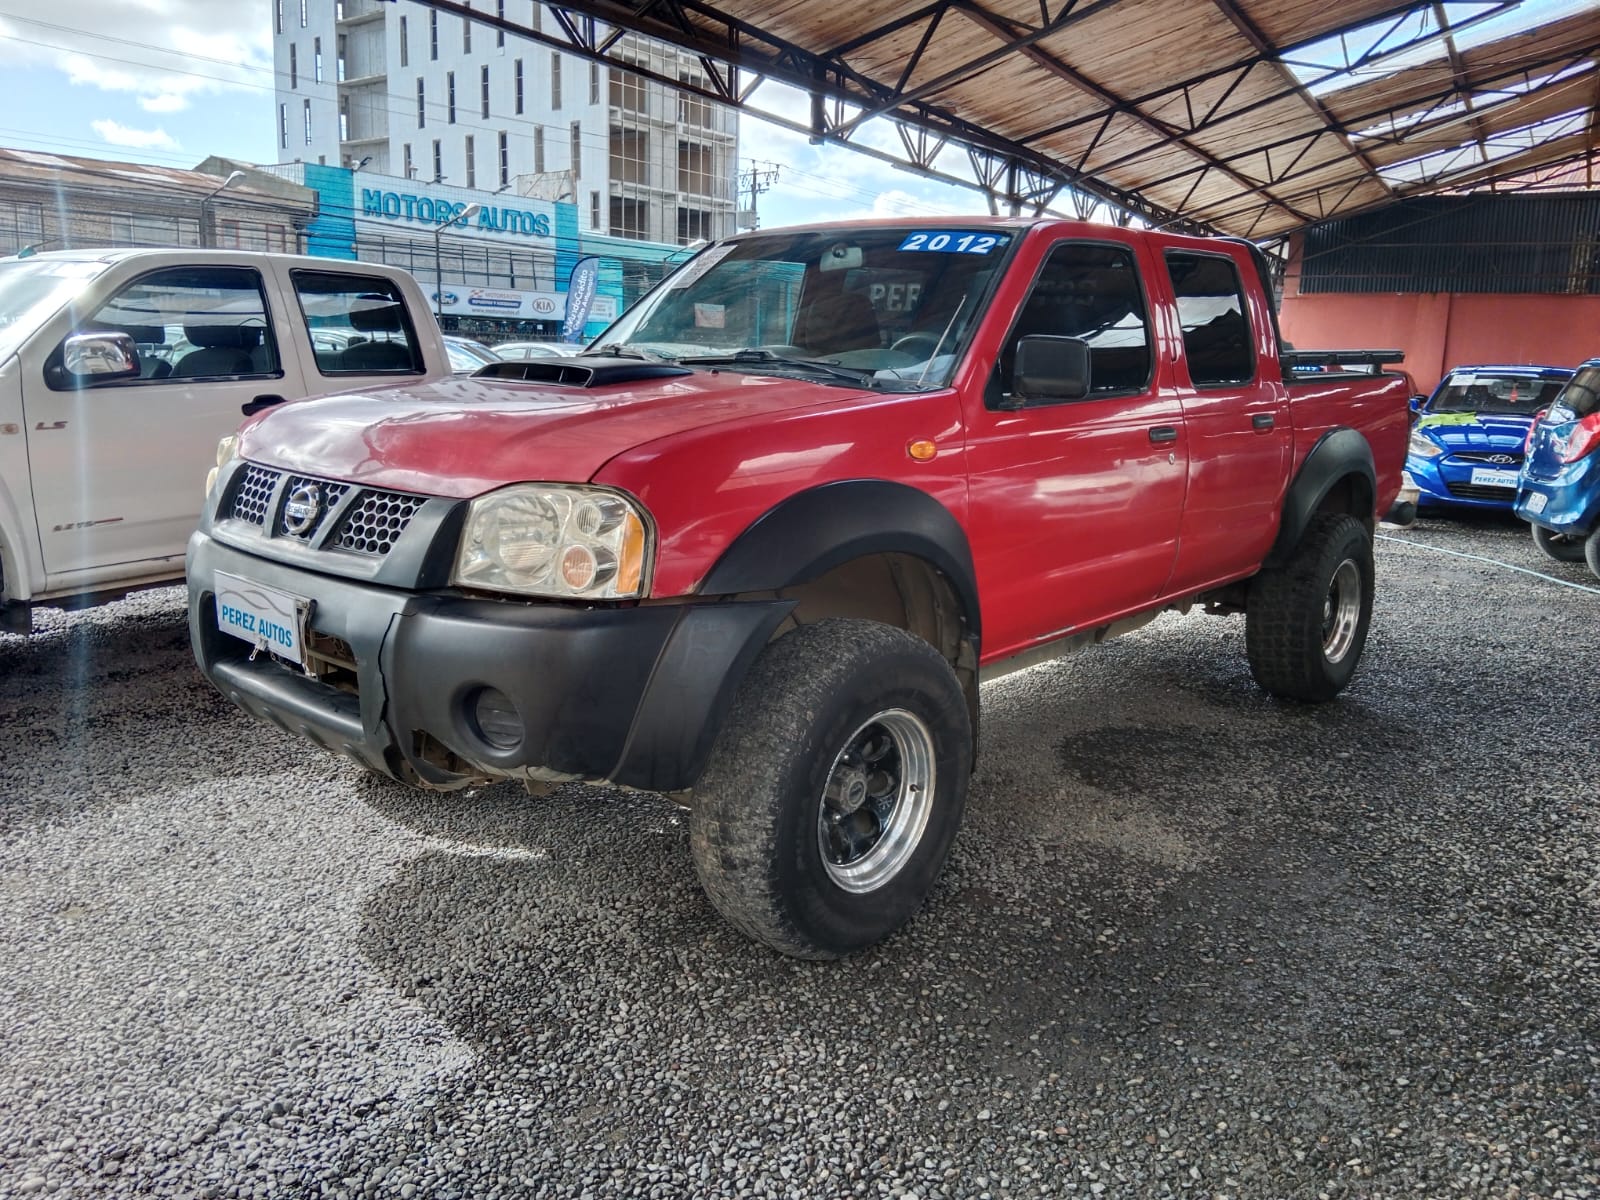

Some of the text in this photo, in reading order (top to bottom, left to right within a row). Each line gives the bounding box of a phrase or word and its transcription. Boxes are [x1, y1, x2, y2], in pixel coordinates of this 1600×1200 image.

[363, 188, 549, 238] MOTORS AUTOS
[902, 234, 996, 254] 2012
[535, 300, 551, 310] KIA
[222, 604, 292, 648] PEREZ AUTOS
